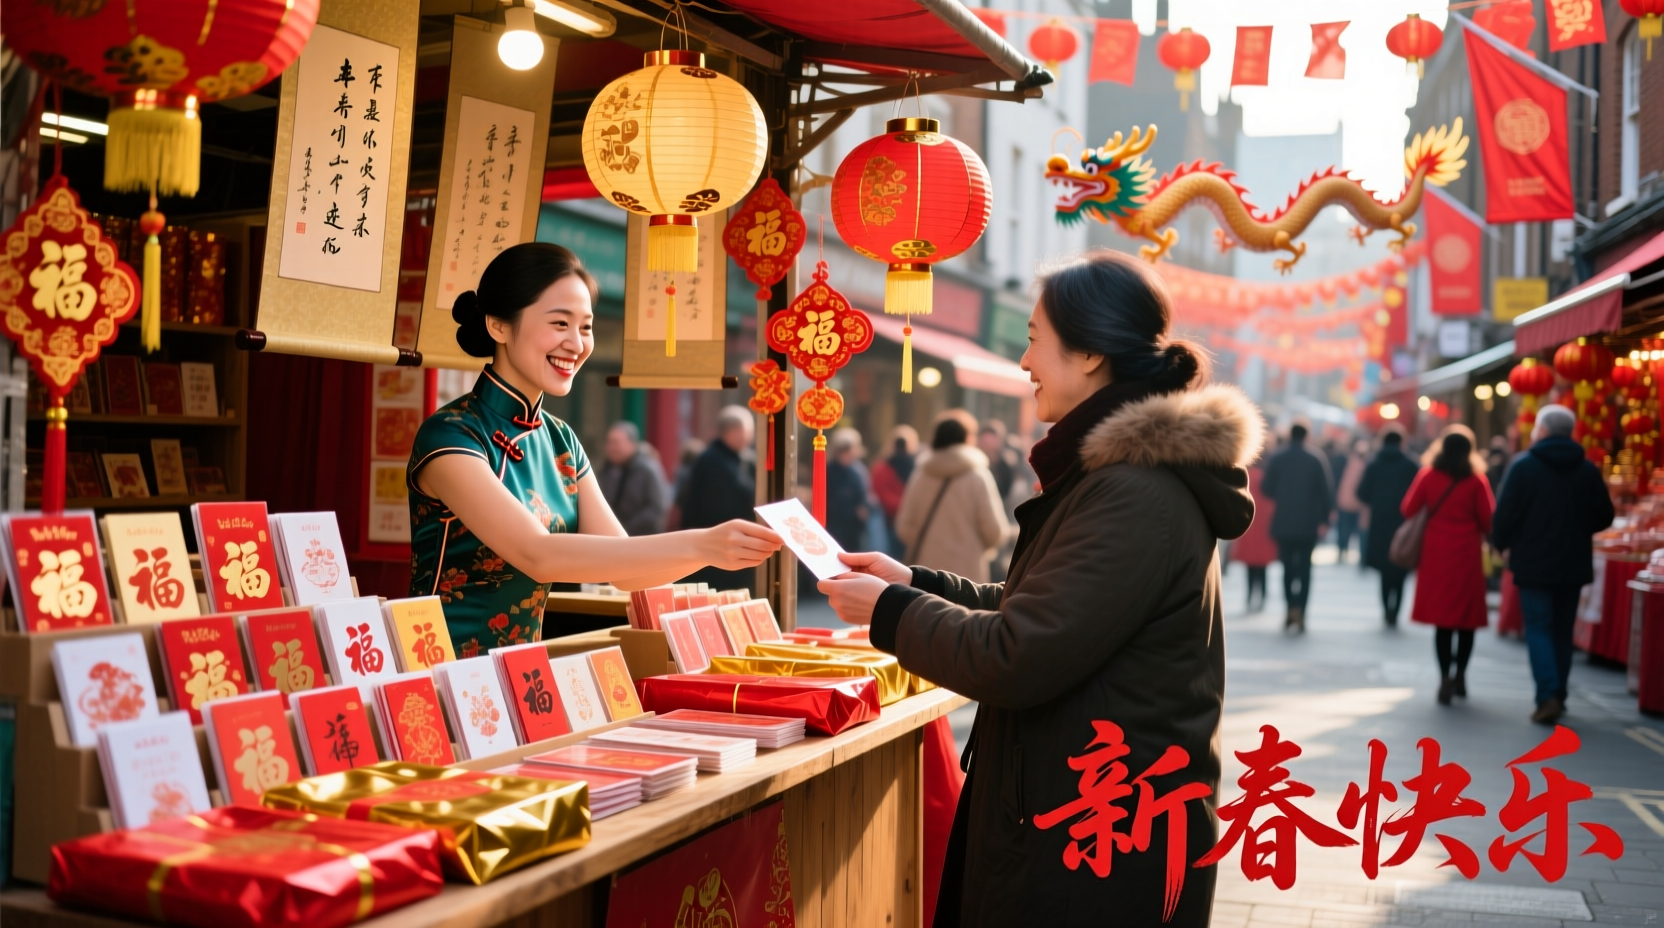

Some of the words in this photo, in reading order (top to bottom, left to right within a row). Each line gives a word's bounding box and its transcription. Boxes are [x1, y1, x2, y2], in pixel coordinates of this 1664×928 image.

[746, 209, 786, 257] 福
[29, 240, 97, 321] 福
[797, 310, 840, 355] 福
[31, 549, 97, 619] 福
[129, 547, 185, 610] 福
[219, 541, 270, 600] 福
[268, 639, 314, 695] 福
[345, 623, 384, 676] 福
[412, 622, 445, 668] 福
[523, 668, 553, 715] 福
[234, 725, 289, 795] 福
